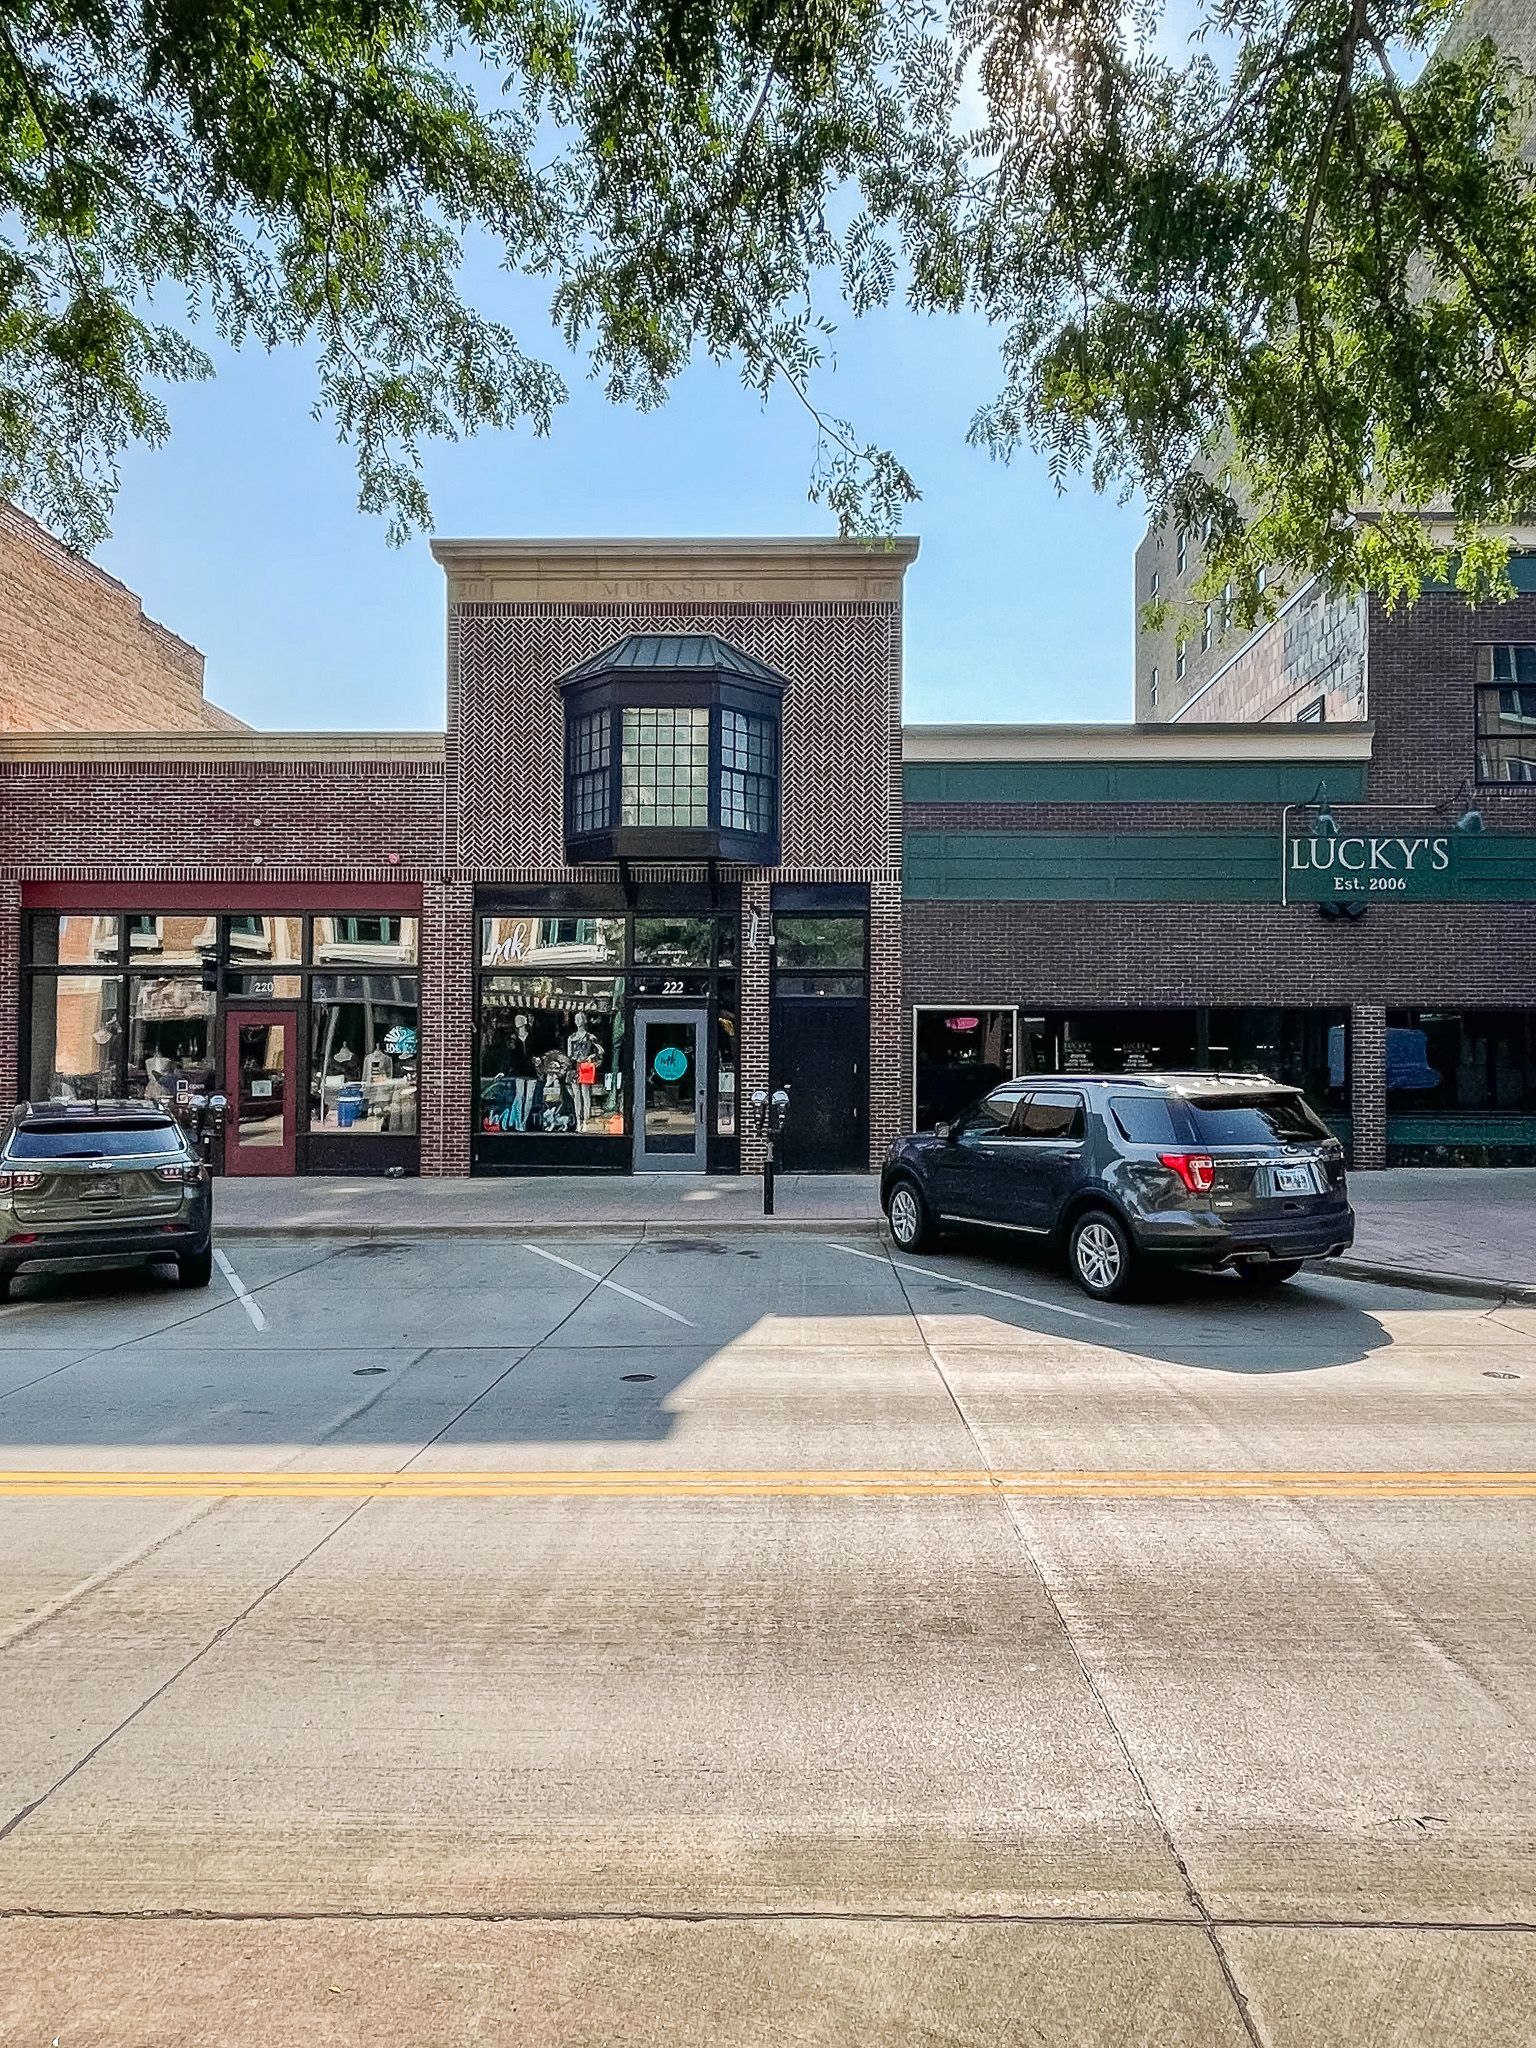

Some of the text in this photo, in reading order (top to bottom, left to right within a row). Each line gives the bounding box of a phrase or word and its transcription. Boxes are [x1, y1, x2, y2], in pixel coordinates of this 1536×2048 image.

[600, 582, 745, 597] MUENSTER
[1290, 838, 1449, 870] LUCKY'S
[1334, 877, 1407, 890] Est. 2006
[254, 982, 274, 993] 220
[662, 981, 684, 994] 222
